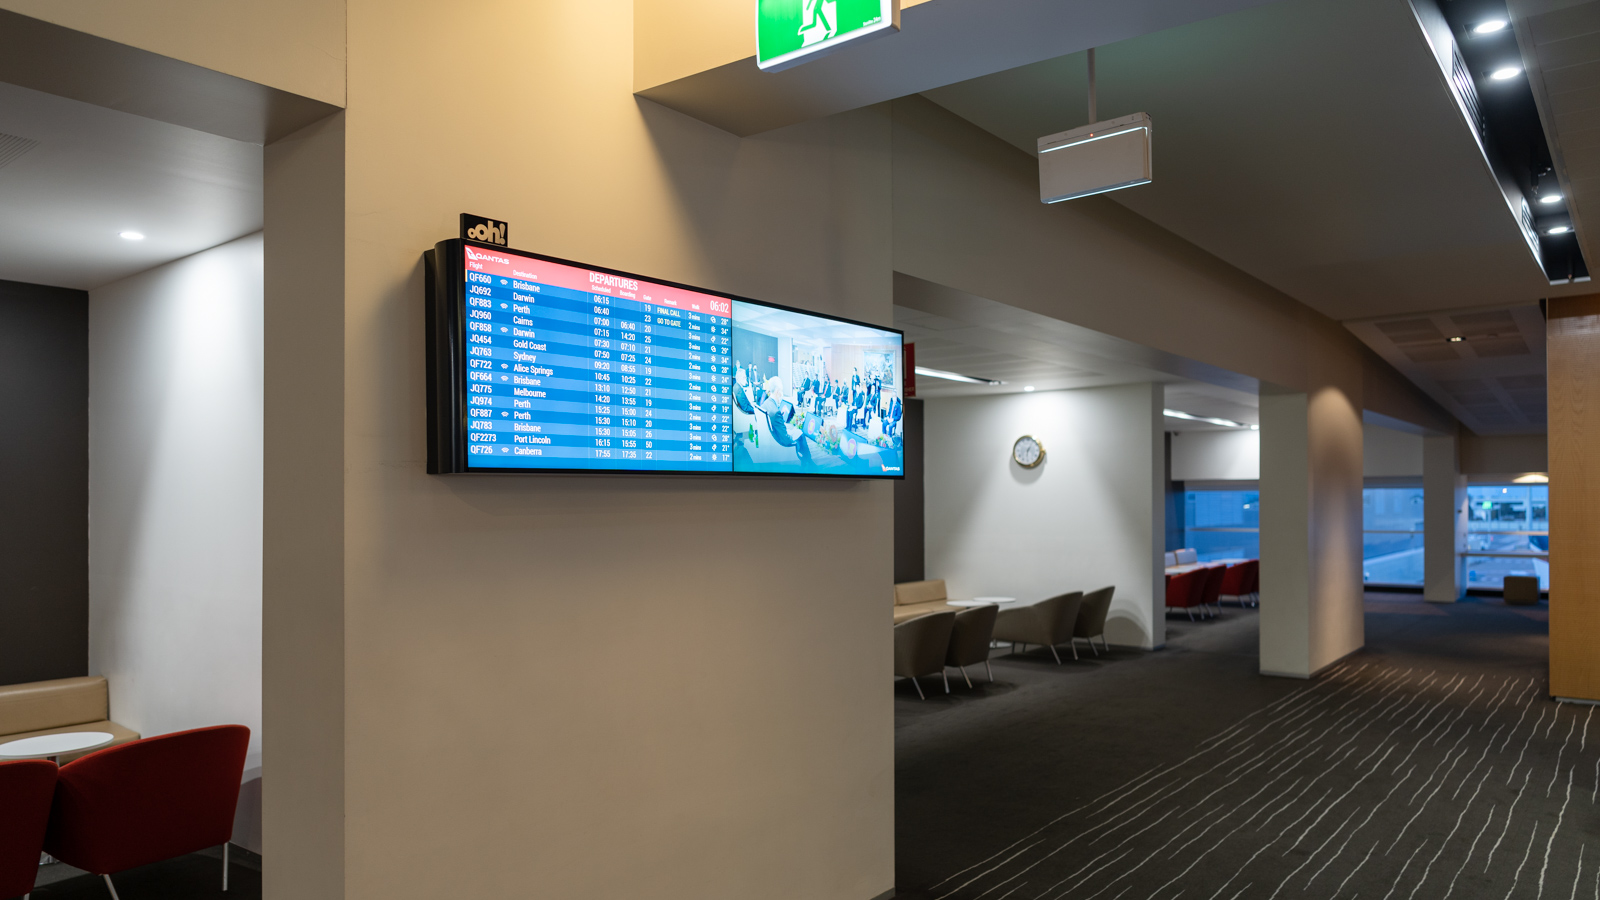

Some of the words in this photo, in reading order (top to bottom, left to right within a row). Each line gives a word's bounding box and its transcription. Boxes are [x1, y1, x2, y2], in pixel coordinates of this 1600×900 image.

[469, 261, 483, 270] Flight
[475, 253, 509, 264] QANTAS
[513, 270, 537, 279] Destination
[590, 272, 638, 291] DEPARTURES
[469, 273, 491, 284] QF660
[513, 280, 540, 292] Brisbane
[594, 295, 609, 304] 06:15
[645, 304, 651, 312] 19
[657, 307, 669, 315] FINAL
[591, 285, 611, 294] Scheduled
[470, 285, 491, 296] JQ692
[513, 292, 534, 303] Darwin
[594, 306, 609, 315] 06:40
[710, 300, 729, 313] 06:02
[470, 297, 491, 308] QF883
[513, 304, 530, 314] Perth
[594, 317, 609, 326] 07:00
[621, 321, 635, 330] 06:40
[470, 310, 491, 320] JQ960
[513, 316, 533, 326] Cairns
[594, 328, 609, 337] 07:15
[621, 332, 635, 341] 14:20
[470, 322, 492, 332] QF858
[513, 328, 535, 338] Darwin
[594, 339, 609, 348] 07:30
[621, 343, 635, 351] 07:10
[470, 334, 492, 344] JQ454
[514, 340, 528, 348] Gold
[529, 342, 546, 351] Coast
[594, 350, 610, 358] 07:50
[621, 354, 635, 362] 07:25
[470, 347, 492, 356] JQ763
[514, 352, 536, 363] Sydney
[595, 361, 610, 369] 09:20
[621, 365, 635, 373] 08:55
[470, 359, 492, 369] QF722
[514, 364, 529, 373] Alice
[530, 366, 553, 377] Springs
[595, 373, 610, 381] 10:45
[622, 375, 636, 383] 10:25
[470, 371, 492, 381] QF664
[514, 376, 541, 386] Brisbane
[595, 384, 610, 392] 13:10
[470, 384, 492, 393] JQ775
[514, 388, 546, 398] Melbourne
[595, 395, 610, 403] 14:20
[622, 397, 636, 405] 13:55
[470, 396, 492, 405] JQ974
[514, 400, 531, 408] Perth
[595, 406, 610, 414] 15:25
[470, 408, 492, 417] QF887
[514, 411, 531, 420] Perth
[471, 421, 492, 430] JQ783
[514, 423, 541, 432] Brisbane
[622, 429, 636, 437] 15:05
[471, 433, 496, 442] QF2273
[514, 435, 527, 443] Port
[529, 435, 551, 444] Lincoln
[471, 445, 493, 454] QF726
[514, 447, 542, 455] Canberra
